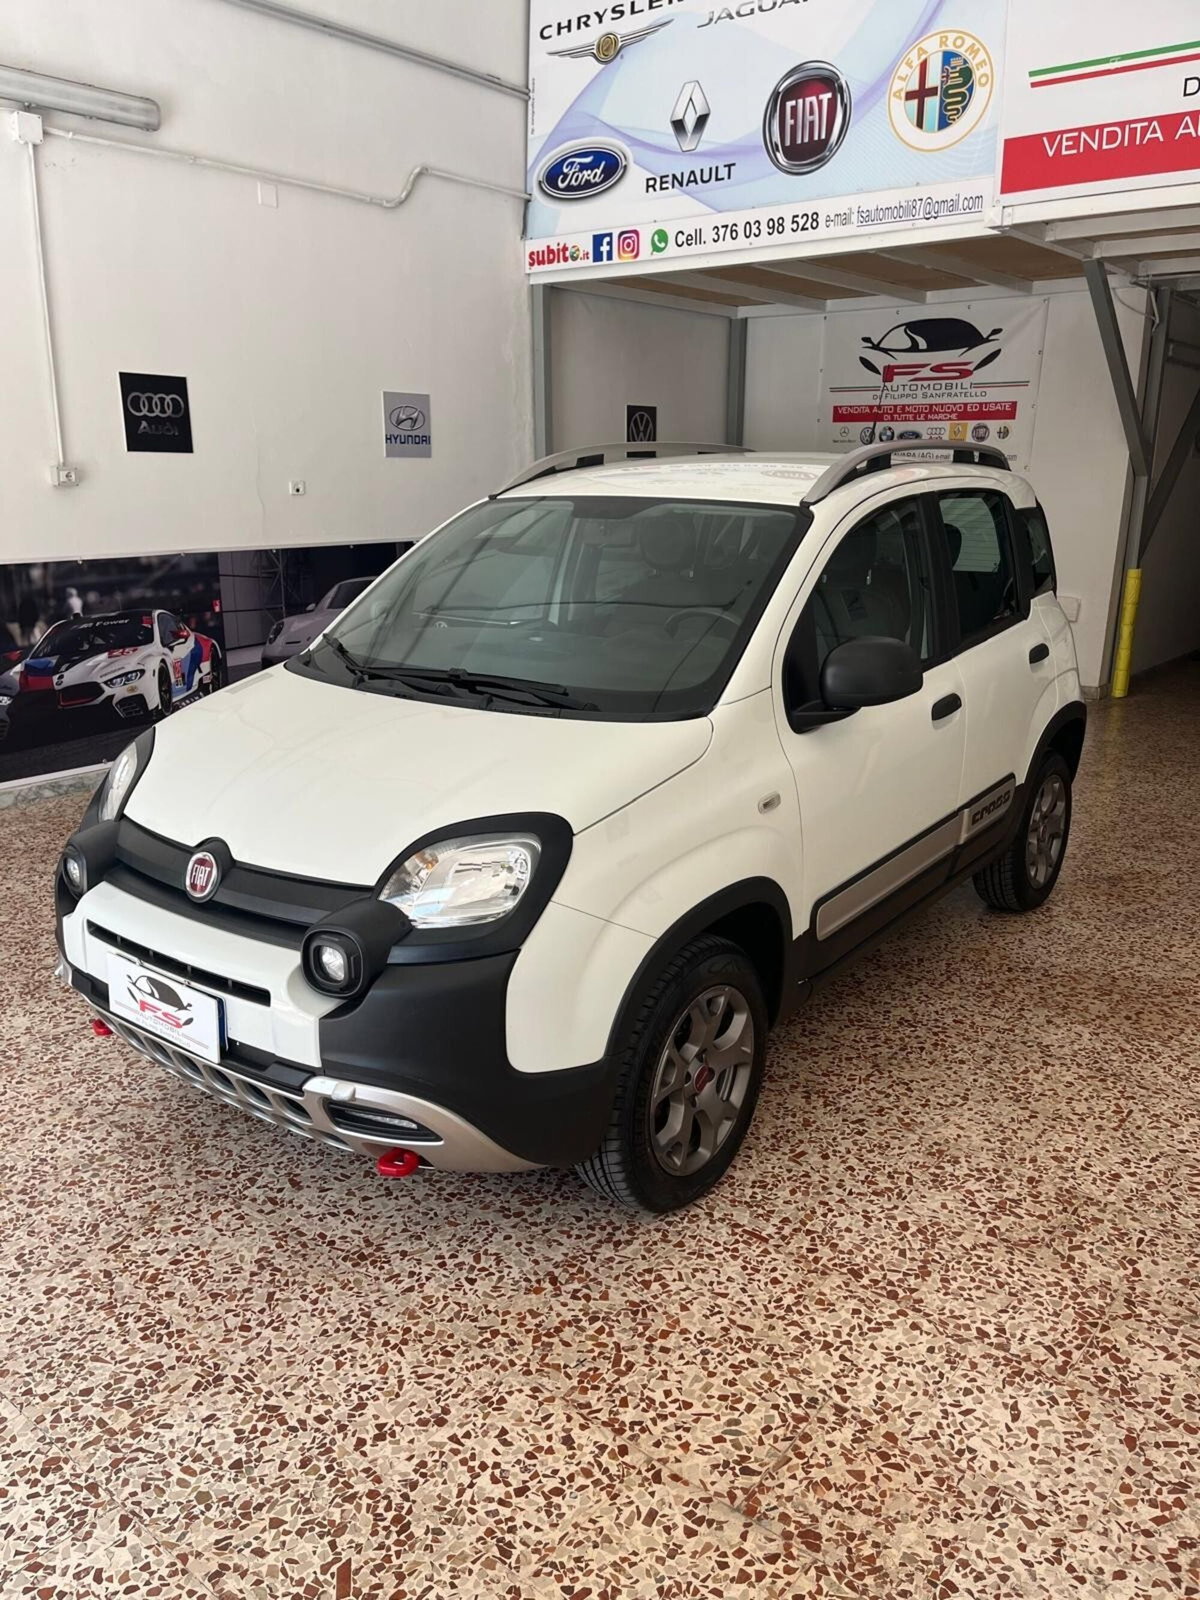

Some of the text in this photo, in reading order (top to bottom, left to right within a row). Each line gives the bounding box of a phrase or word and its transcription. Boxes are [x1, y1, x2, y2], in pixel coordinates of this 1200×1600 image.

[697, 0, 808, 28] JAGUA
[892, 35, 990, 100] ALFA ROMEO
[785, 91, 832, 147] FIAT
[1042, 115, 1200, 158] VENDITA A
[557, 155, 606, 189] Ford
[645, 163, 736, 193] RENAULT
[675, 193, 984, 247] Cell. 376 03 98 528 e-mail: fsautomobili87@gmail.com
[882, 361, 974, 383] FS
[881, 382, 973, 393] AUTOMOBILI
[884, 392, 917, 400] FILIPPO
[921, 391, 987, 399] SANFRATELLO
[838, 406, 870, 414] VENDITA
[896, 405, 902, 413] E
[905, 405, 930, 413] MOTO
[932, 404, 964, 412] NUOVO
[967, 403, 980, 411] ED
[982, 403, 1012, 411] USATE
[138, 420, 180, 436] Audi
[385, 433, 431, 445] HYUNDAI
[95, 618, 130, 627] Power
[190, 863, 211, 887] FIAT
[139, 999, 183, 1029] FS
